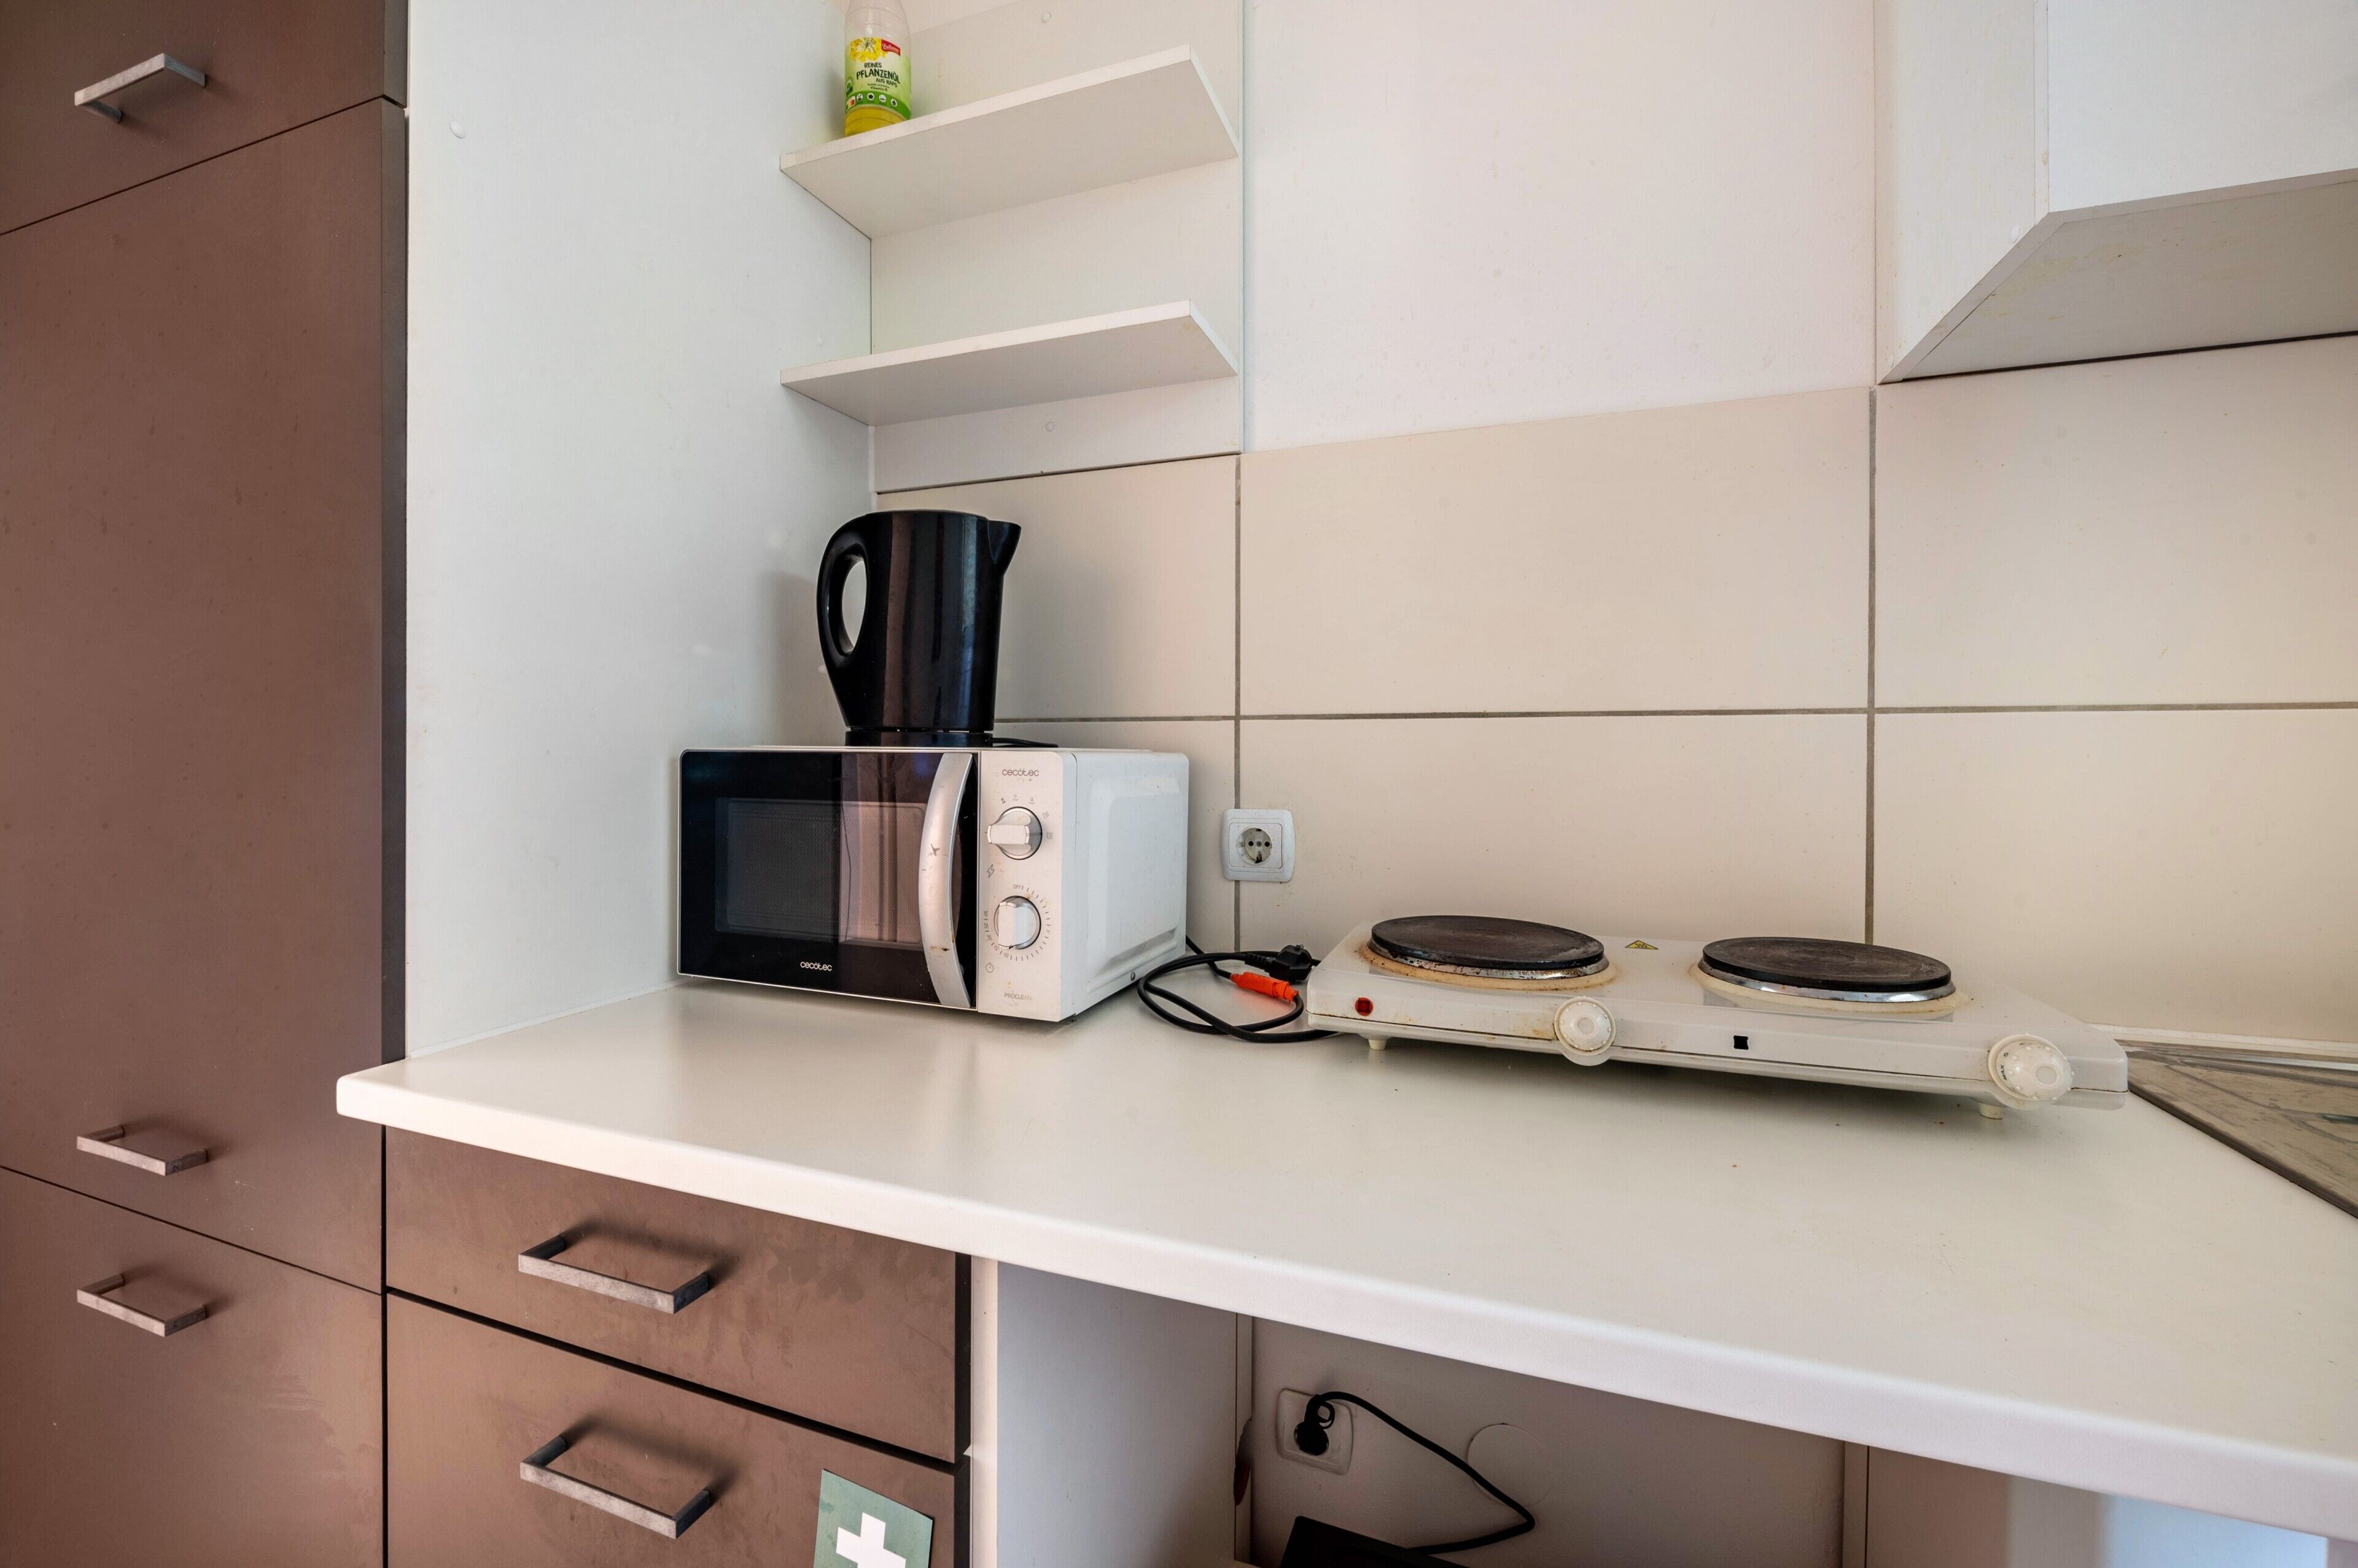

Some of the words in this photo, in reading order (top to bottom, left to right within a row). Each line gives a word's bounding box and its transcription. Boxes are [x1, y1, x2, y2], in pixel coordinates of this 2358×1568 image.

[856, 68, 900, 83] PFLANZENÖL
[1002, 768, 1039, 777] cecotec
[800, 961, 833, 971] cecotec
